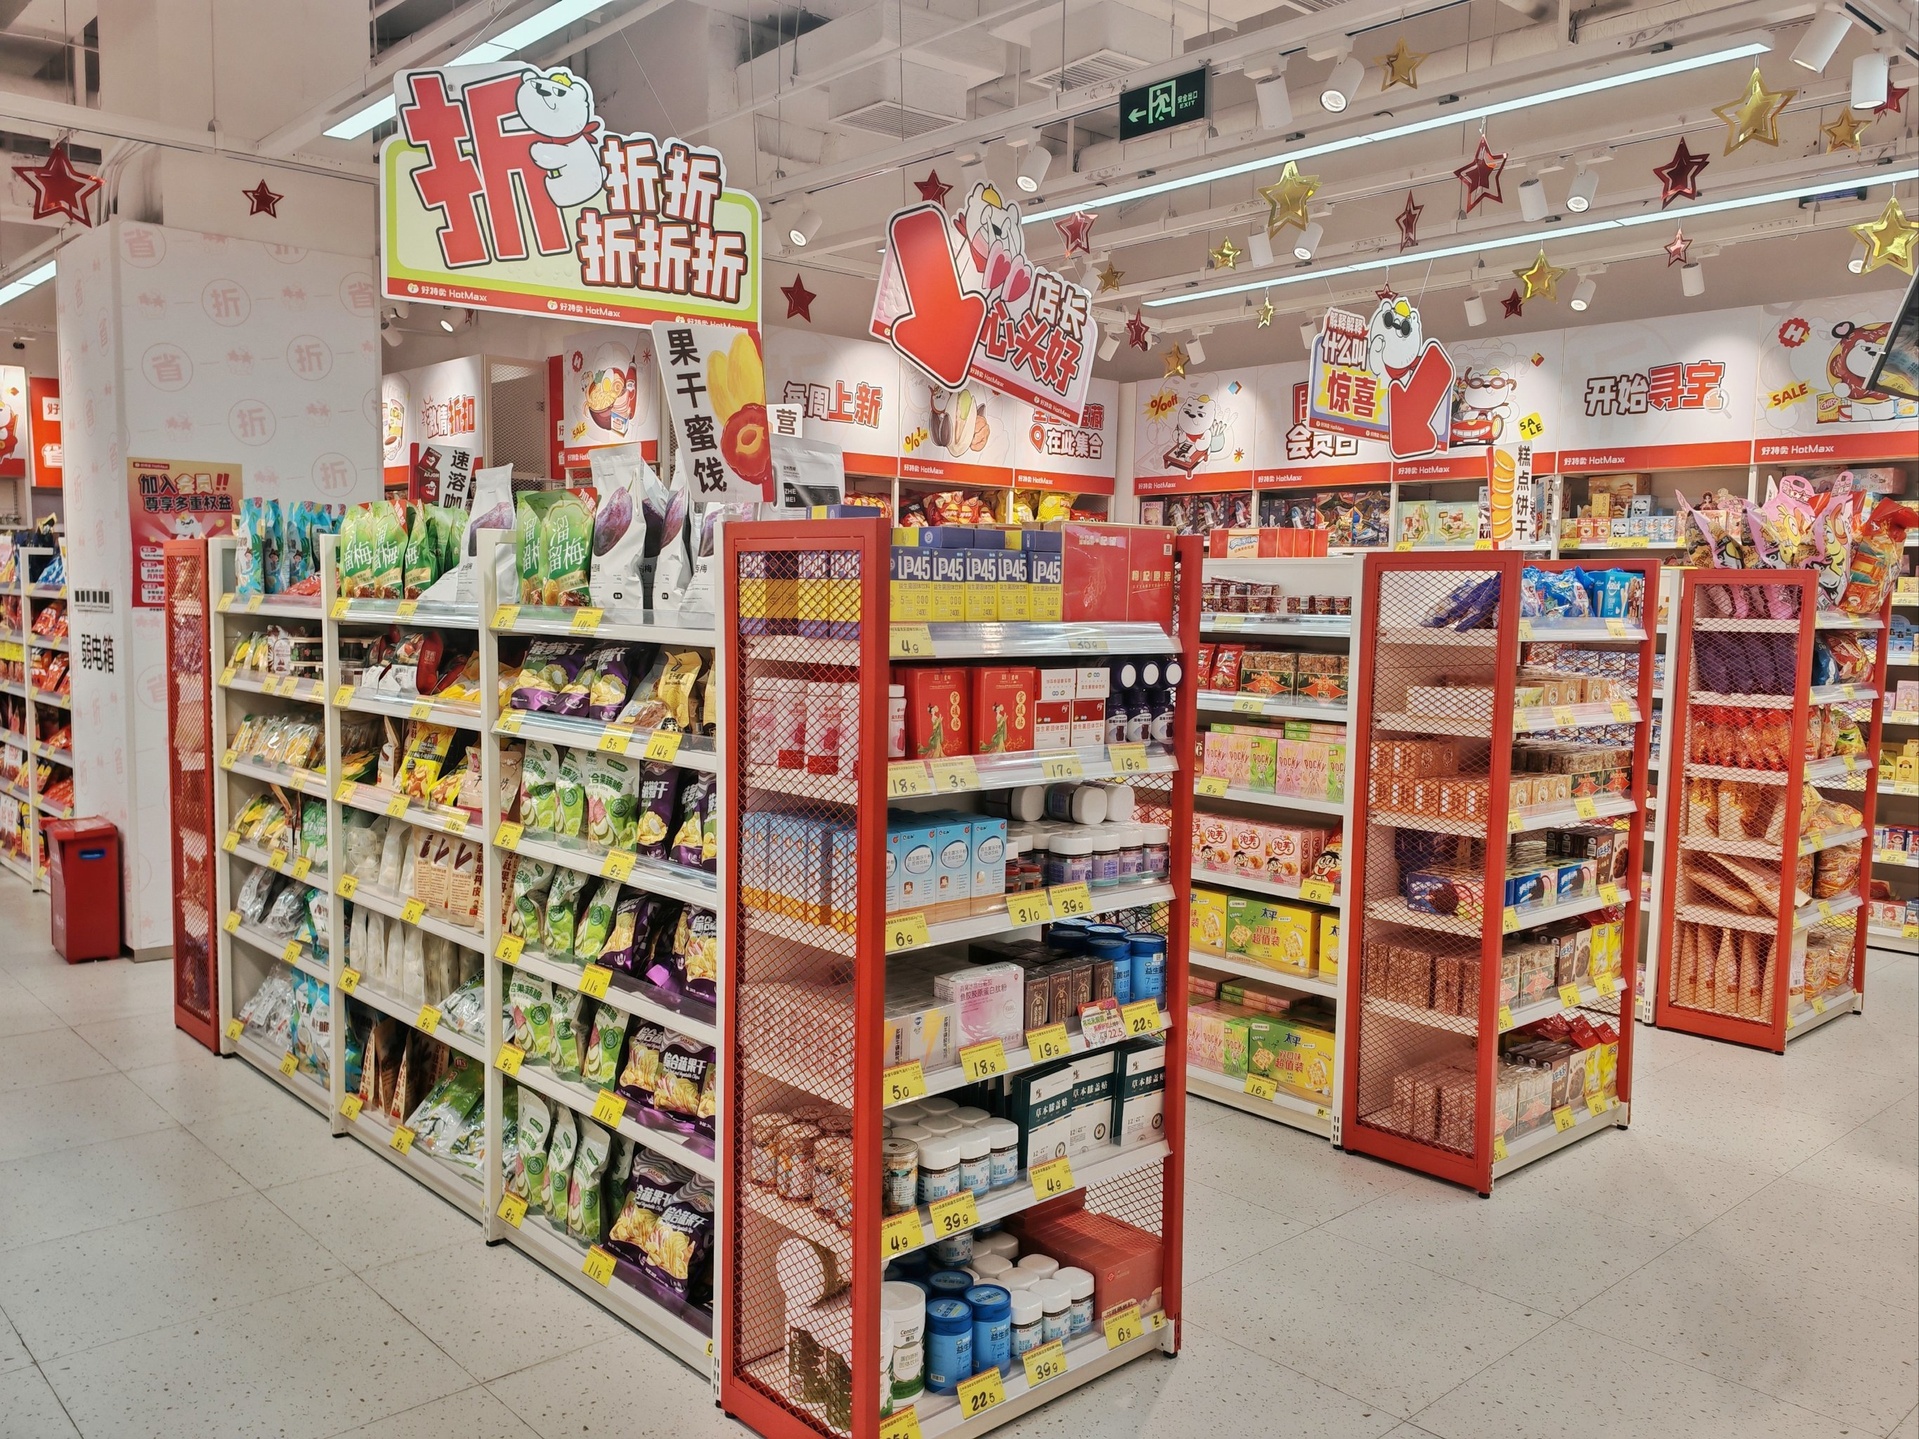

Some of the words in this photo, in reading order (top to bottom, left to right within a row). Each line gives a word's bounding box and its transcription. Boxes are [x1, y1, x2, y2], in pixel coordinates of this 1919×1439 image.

[1180, 100, 1196, 109] EXIT
[400, 68, 571, 269] 折
[601, 135, 724, 226] 折折
[577, 208, 748, 303] 折折折
[1031, 273, 1089, 341] 店长
[980, 300, 1084, 396] 心头好
[1321, 331, 1369, 371] 什么叫
[1327, 369, 1377, 419] 惊喜
[1585, 359, 1726, 417] 开始寻宝
[1772, 382, 1809, 407] SALE
[427, 394, 476, 439] 激情折扣
[667, 328, 727, 494] 果干蜜饯
[776, 408, 798, 436] 营
[572, 422, 586, 439] SALE
[1046, 427, 1103, 459] 在此集合
[1588, 456, 1626, 465] HotMaxx
[1761, 446, 1789, 456] 好特卖
[1791, 444, 1834, 454] HotMaxx
[443, 449, 470, 509] 速溶咖
[1515, 444, 1531, 540] 糕点饼干
[144, 494, 232, 513] 尊享多重权益
[81, 633, 114, 674] 弱电箱
[1261, 908, 1278, 920] 太平
[1252, 934, 1280, 948] 超值装
[1285, 1033, 1302, 1046] 太平
[1275, 1060, 1304, 1072] 超值装
[1073, 1080, 1108, 1098] 草本膝盖贴
[1036, 1097, 1068, 1118] 草本膝盖贴
[900, 1326, 918, 1336] Centrum
